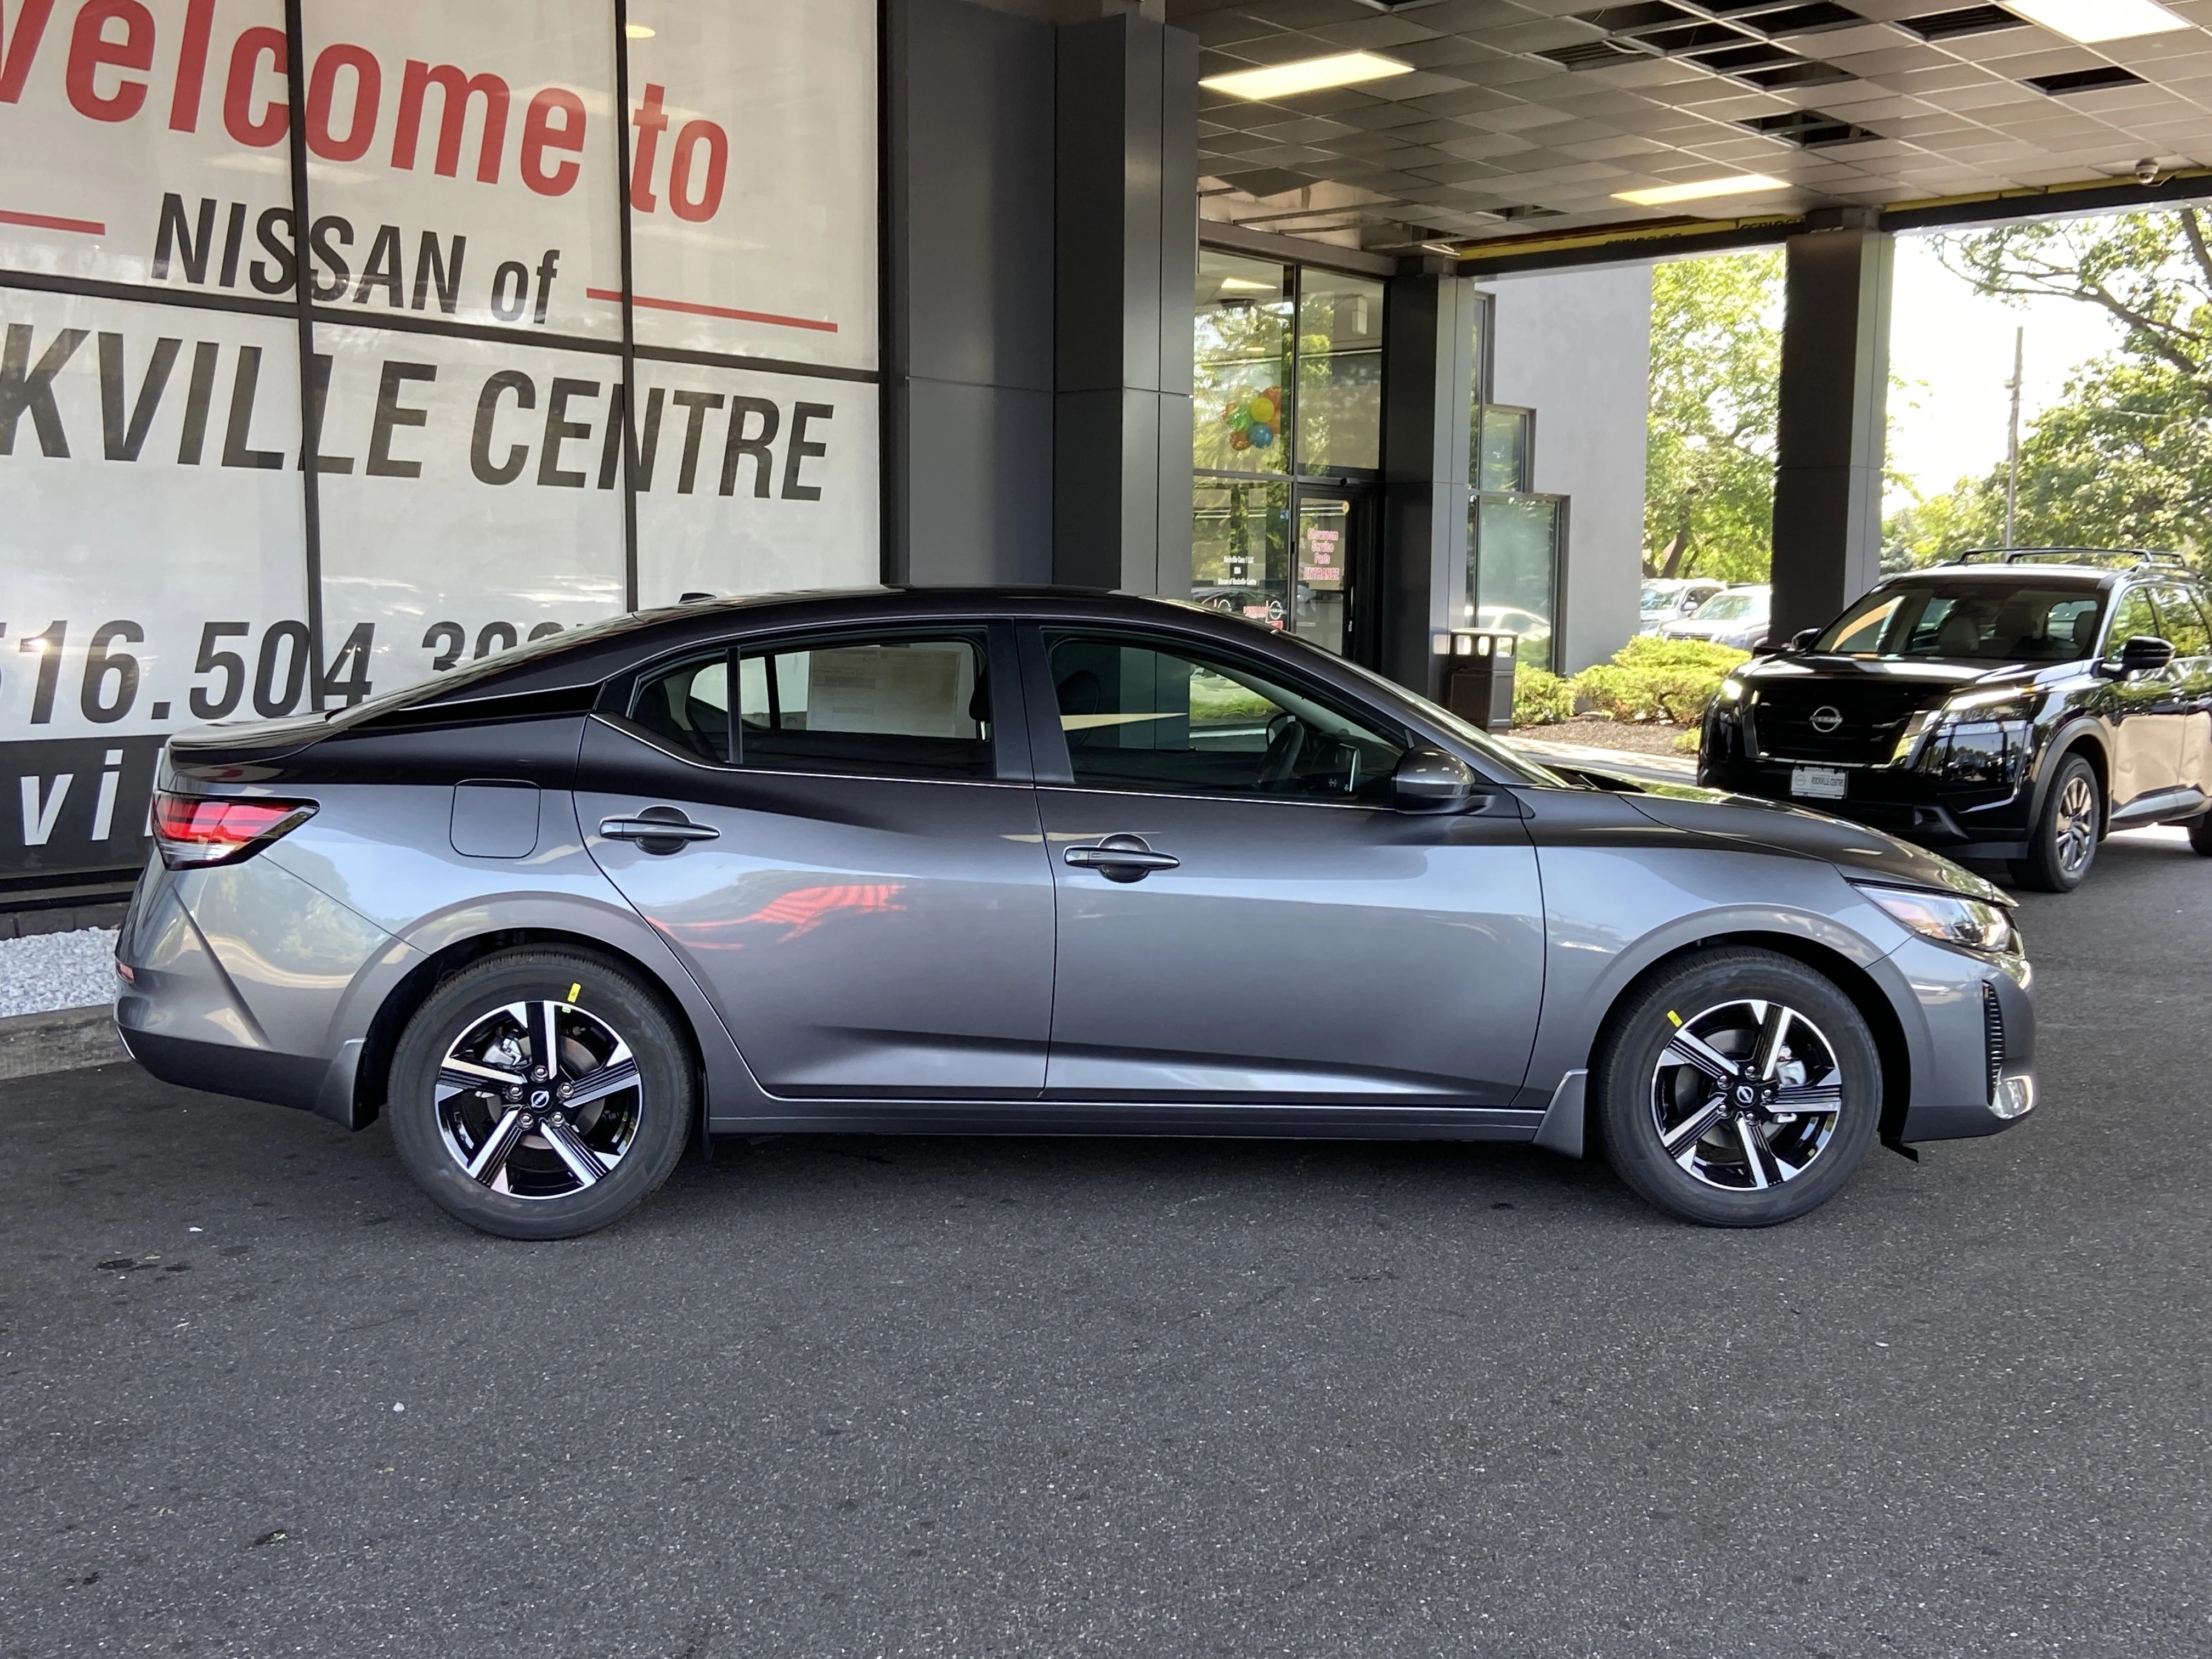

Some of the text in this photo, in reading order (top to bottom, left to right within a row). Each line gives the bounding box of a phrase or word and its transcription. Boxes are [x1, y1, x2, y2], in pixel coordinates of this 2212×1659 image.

[630, 83, 729, 223] to
[151, 193, 560, 324] NISSAN of
[0, 323, 834, 501] KVILLE CENTRE
[1304, 567, 1340, 580] ENTRANCE
[1312, 540, 1334, 552] Service
[20, 748, 165, 846] vi
